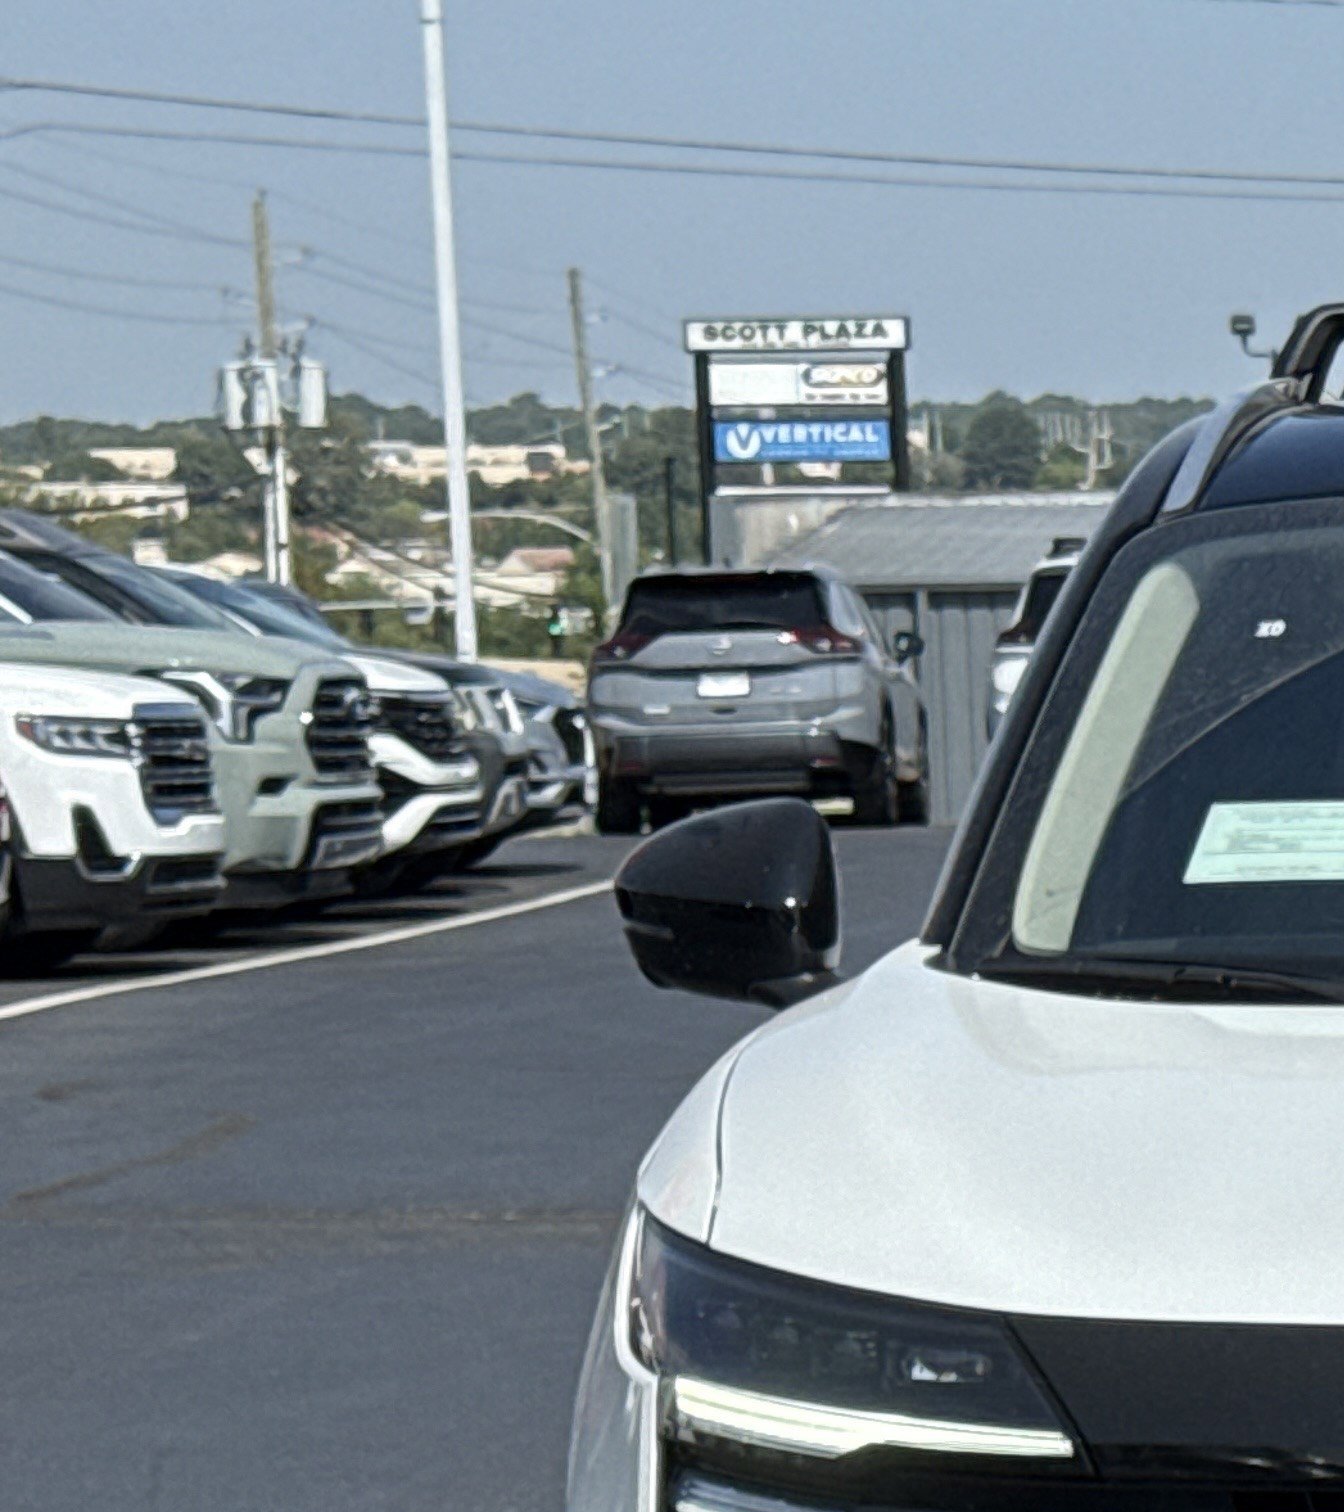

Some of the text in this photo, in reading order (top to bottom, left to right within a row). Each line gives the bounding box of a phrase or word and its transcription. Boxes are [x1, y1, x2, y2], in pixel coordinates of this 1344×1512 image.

[703, 322, 889, 342] SCOTT PLAZA
[761, 423, 879, 443] VERTICAL
